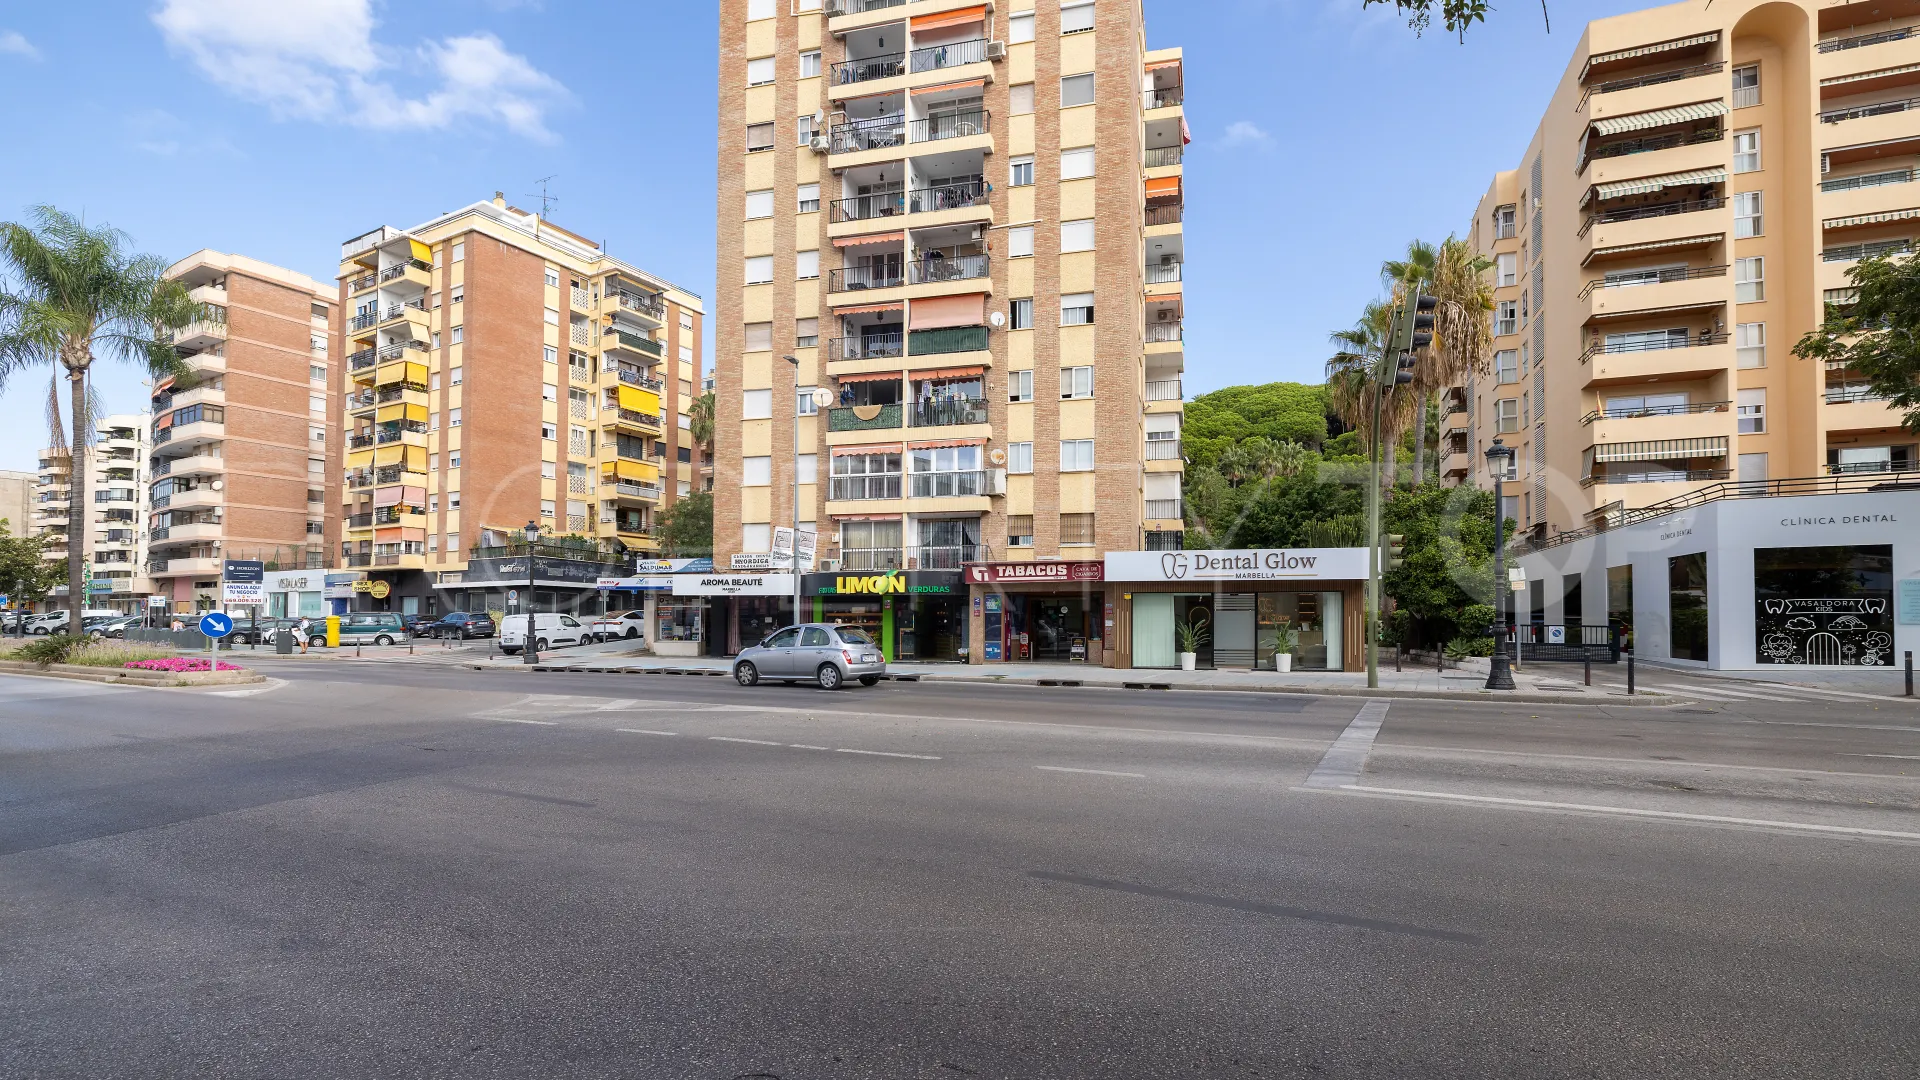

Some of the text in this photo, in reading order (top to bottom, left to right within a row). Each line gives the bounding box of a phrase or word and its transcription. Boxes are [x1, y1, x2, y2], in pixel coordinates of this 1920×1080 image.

[1780, 514, 1897, 526] CLÍNICA DENTAL
[1677, 528, 1692, 538] DENTAL
[1194, 552, 1317, 570] Dental Glow
[996, 564, 1068, 576] TABACOS
[700, 577, 763, 586] AROMA BEAUTÉ
[907, 585, 950, 593] VERDURAS
